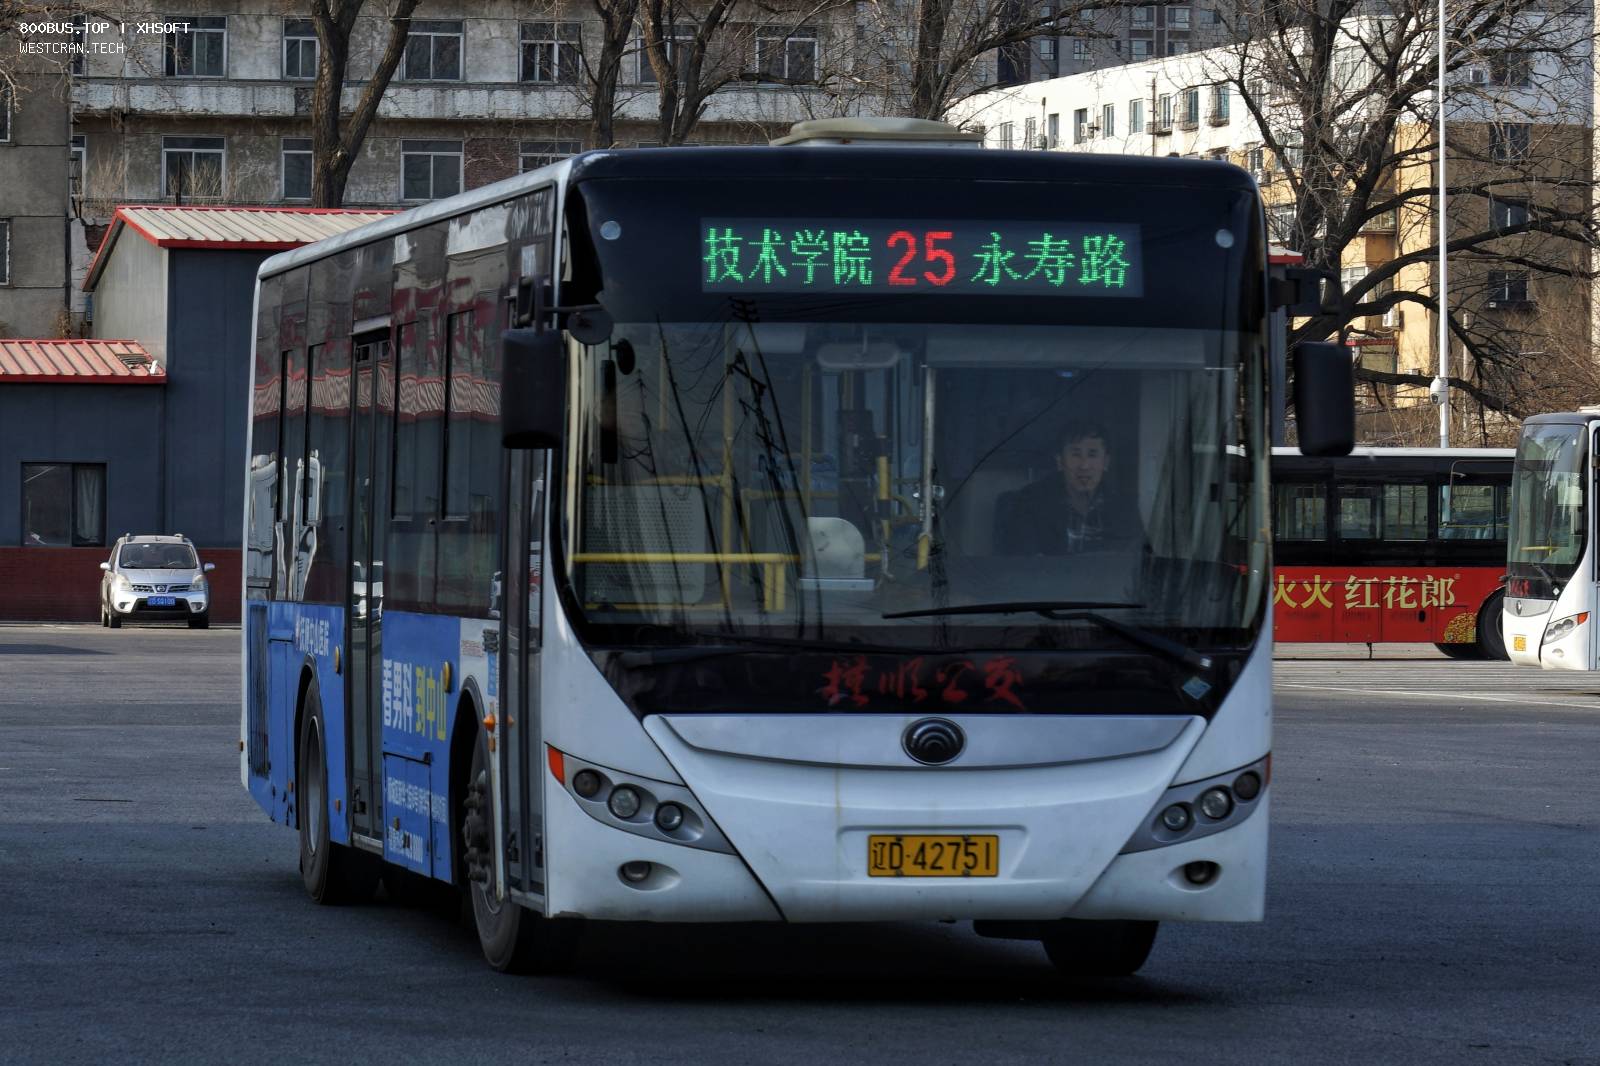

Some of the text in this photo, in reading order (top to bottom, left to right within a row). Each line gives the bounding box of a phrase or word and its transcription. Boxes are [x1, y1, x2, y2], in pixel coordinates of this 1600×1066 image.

[704, 228, 1130, 287] 技术学院 25 永寿路
[1345, 575, 1455, 610] 红花郎
